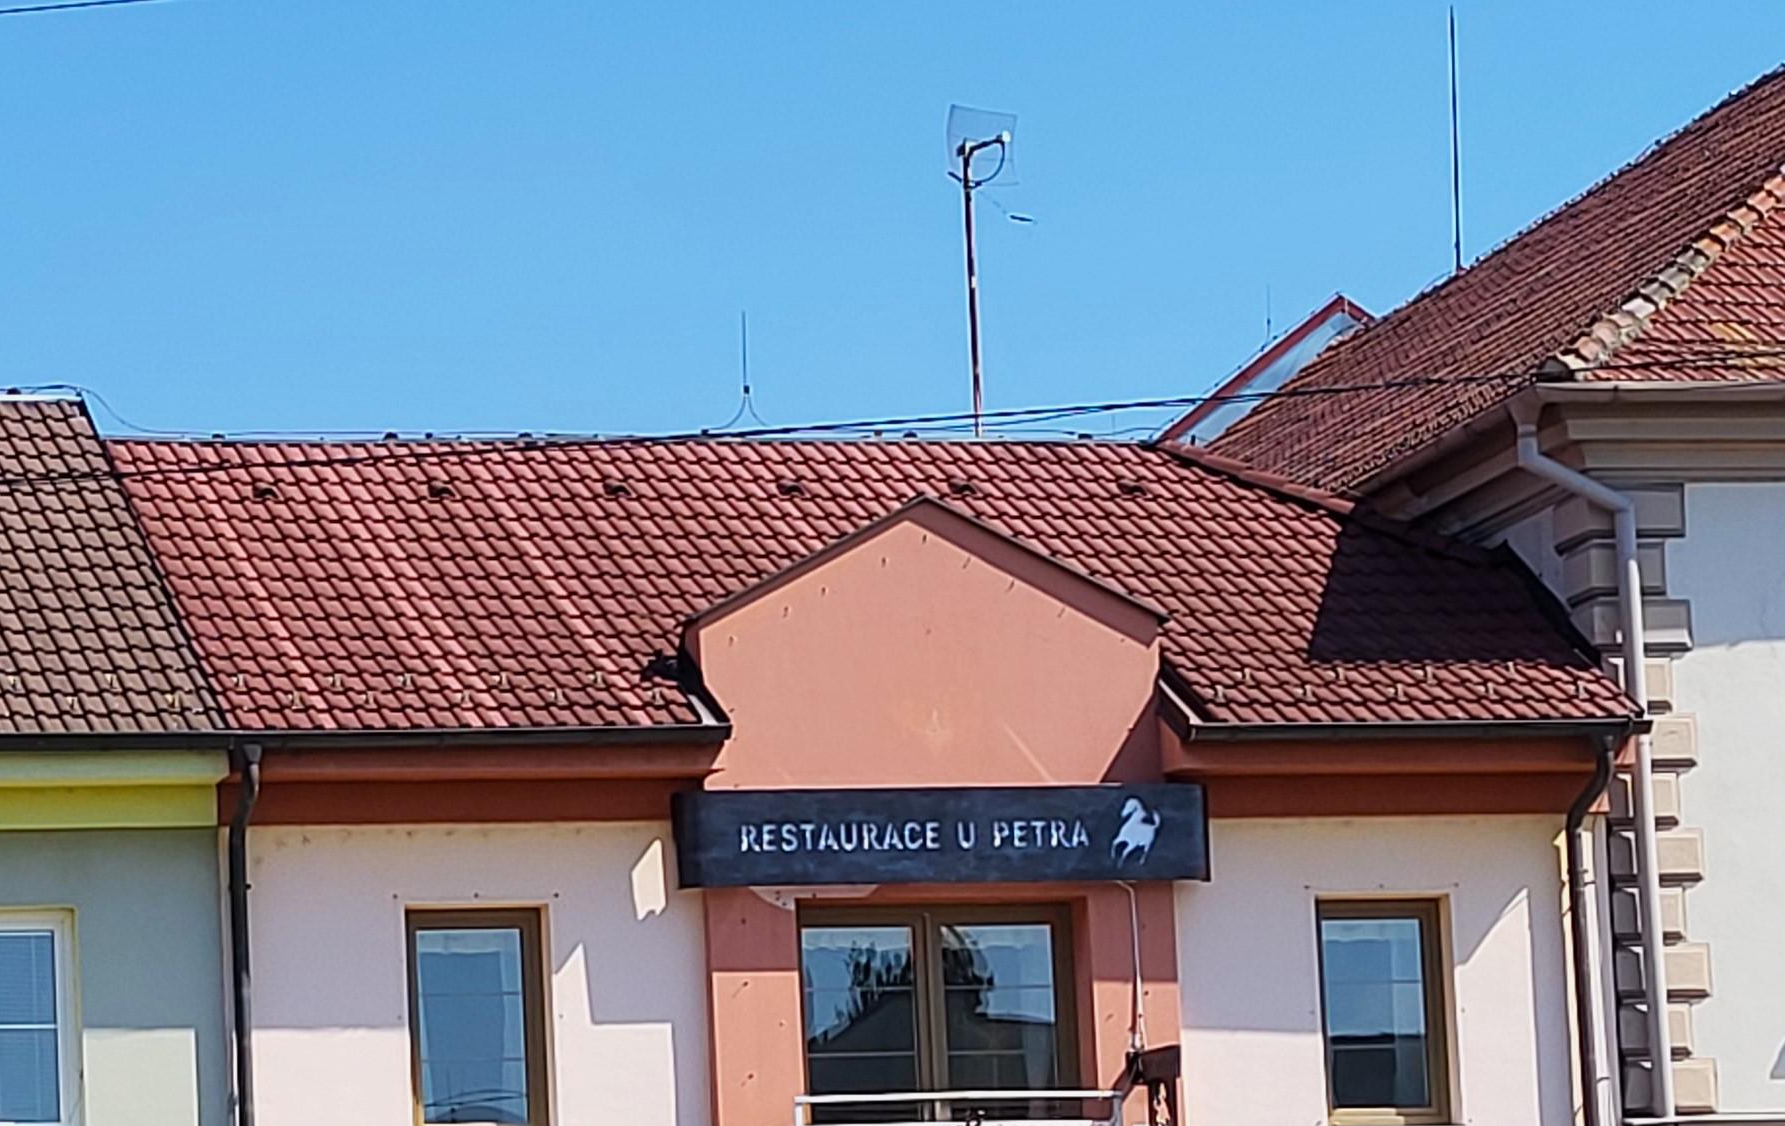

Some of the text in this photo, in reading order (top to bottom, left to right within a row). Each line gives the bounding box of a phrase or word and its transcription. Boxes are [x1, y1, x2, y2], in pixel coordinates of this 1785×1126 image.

[740, 819, 1090, 853] RESTAURACE U PETRA
